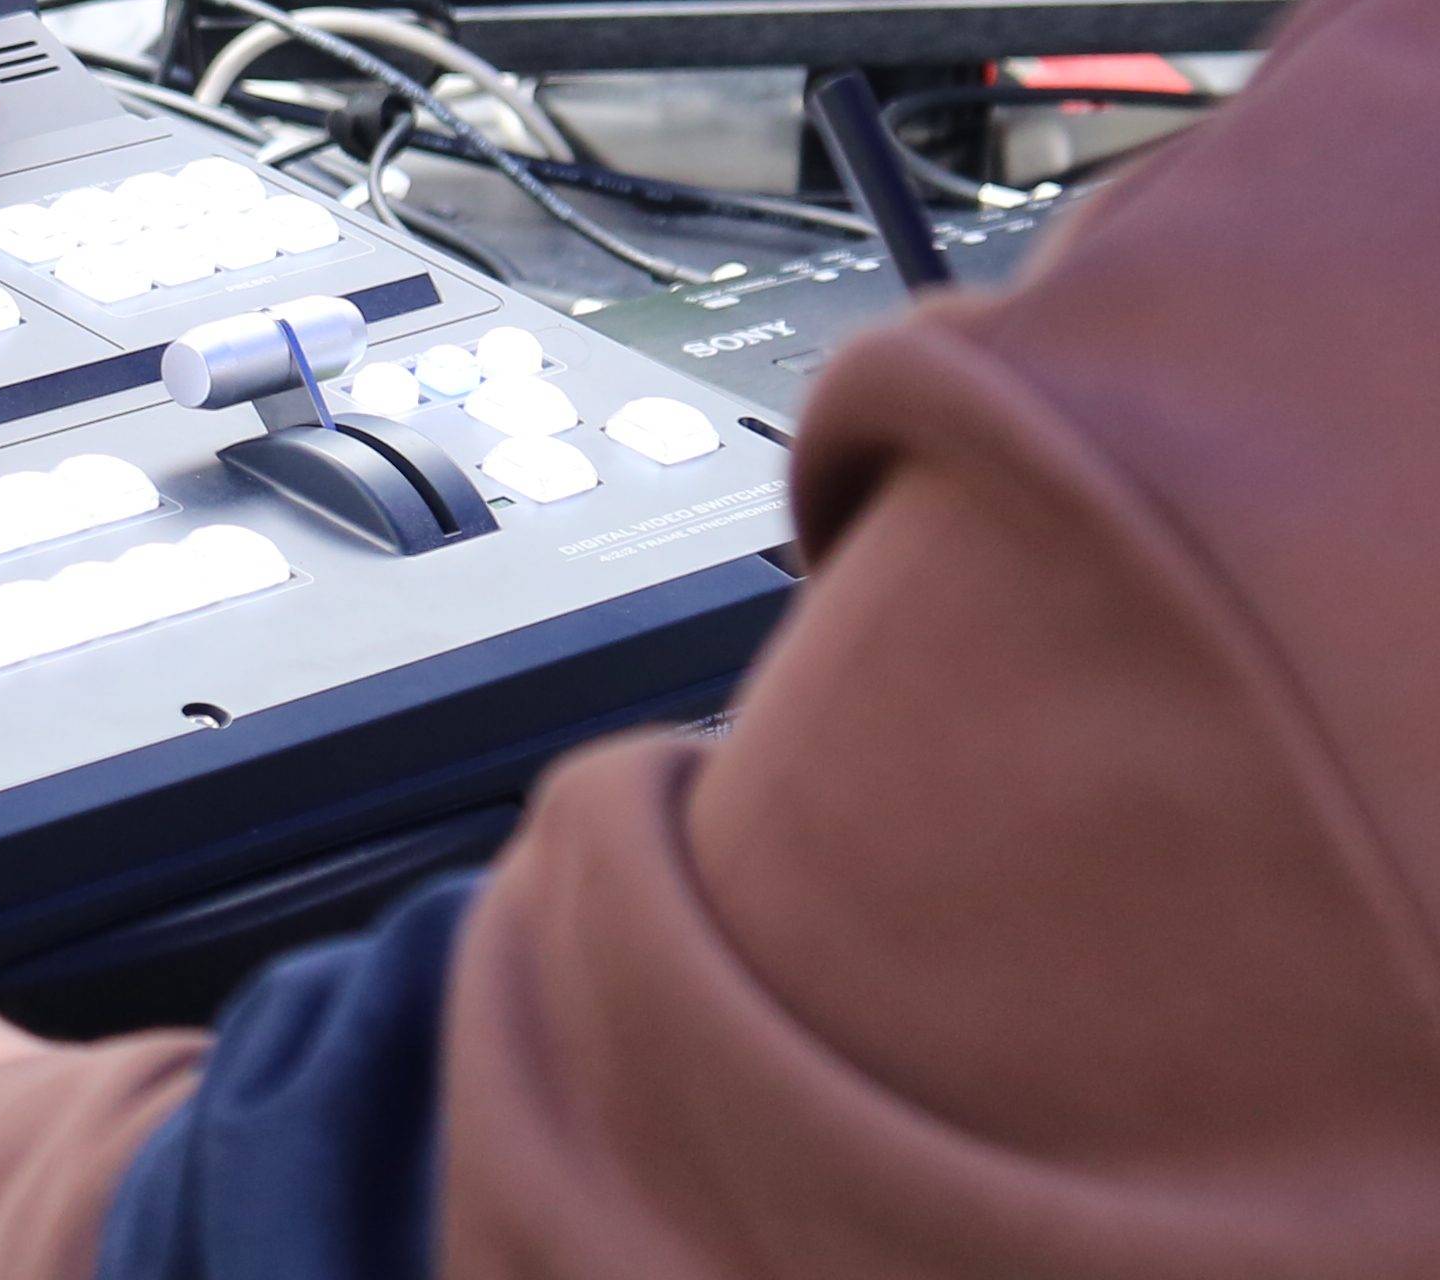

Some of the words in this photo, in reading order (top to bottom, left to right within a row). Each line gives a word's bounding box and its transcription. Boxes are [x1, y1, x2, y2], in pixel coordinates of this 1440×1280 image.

[683, 316, 797, 360] SONY
[558, 528, 637, 557] DIGITAL
[631, 507, 695, 535] VIDEO
